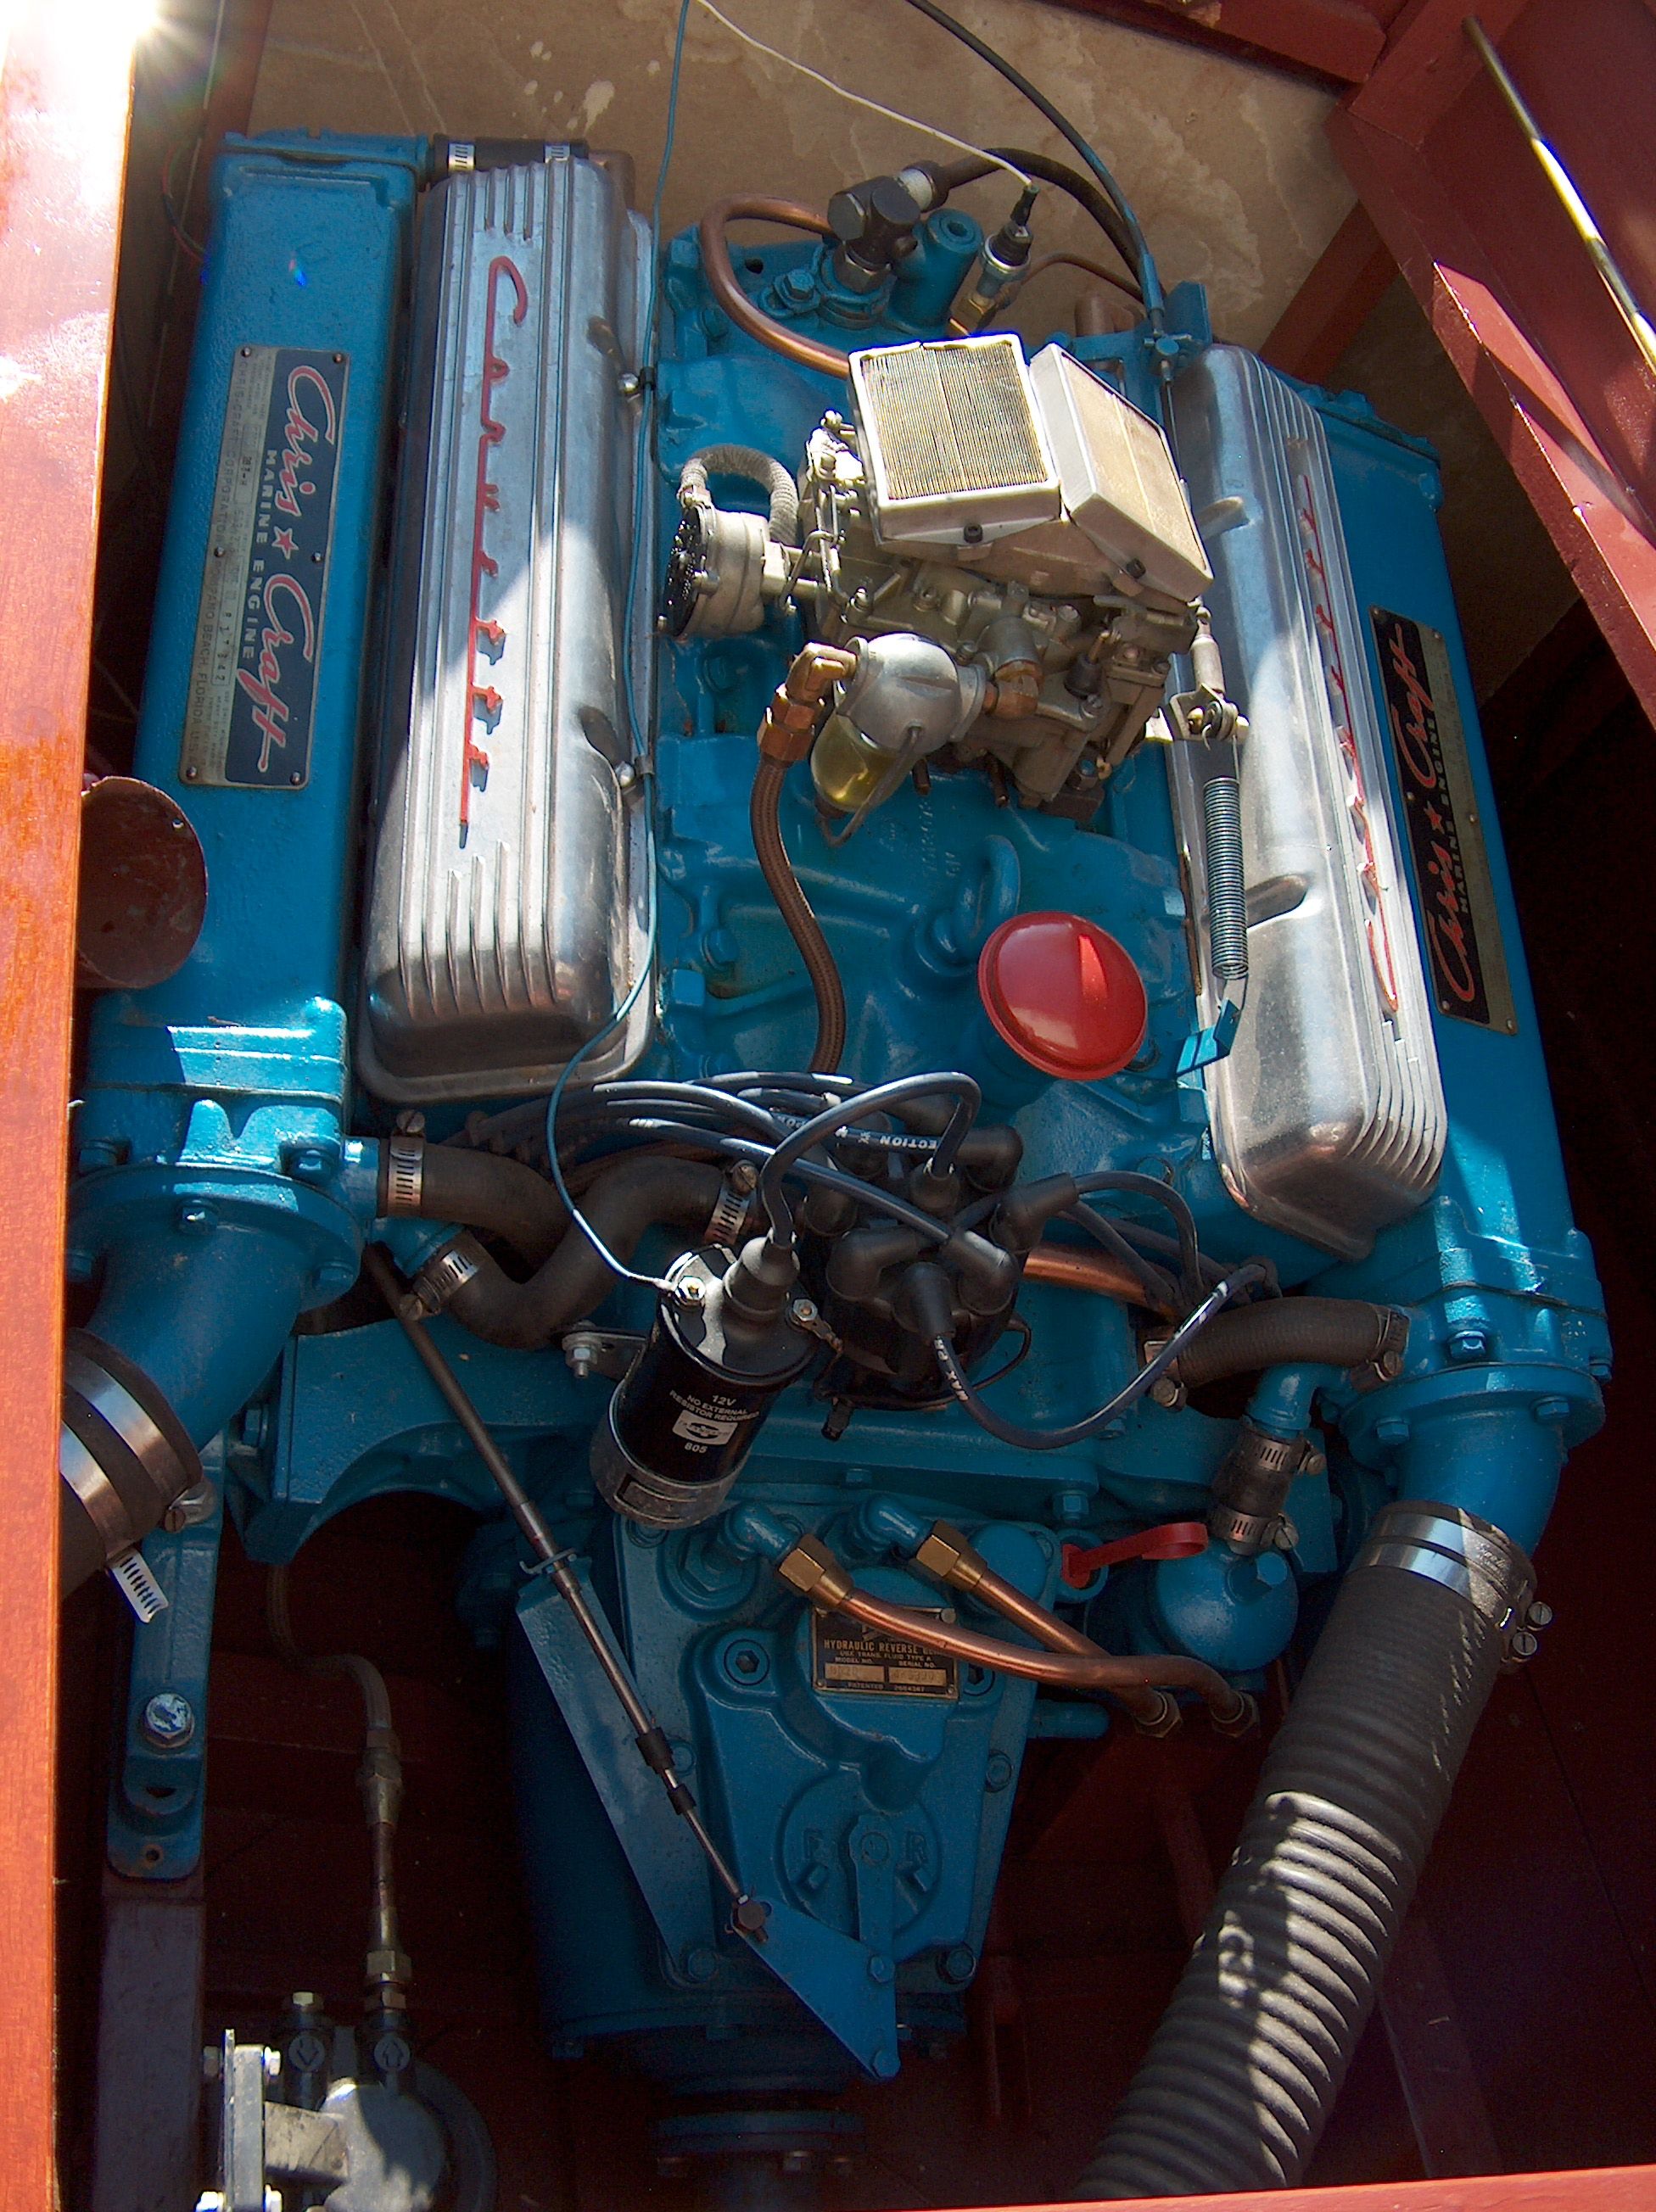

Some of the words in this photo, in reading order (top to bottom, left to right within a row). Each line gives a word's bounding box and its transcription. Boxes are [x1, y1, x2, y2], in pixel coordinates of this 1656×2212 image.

[277, 365, 334, 517] Chris
[256, 449, 277, 544] MARINE
[241, 559, 264, 660] ENGINE
[192, 672, 207, 726] FLORIDA
[238, 573, 311, 772] Craft
[1391, 623, 1434, 787] Craft
[1426, 716, 1450, 806] ENGINE
[1445, 818, 1469, 913] MARINE
[1426, 840, 1477, 1002] Chris
[669, 1390, 714, 1417] RESISTOR
[688, 1394, 701, 1405] NO
[702, 1403, 747, 1415] EXTERNAL
[713, 1395, 736, 1406] 12V
[684, 1442, 708, 1454] 805
[824, 1639, 875, 1651] HYDRAULIC
[879, 1641, 918, 1654] REVERSE
